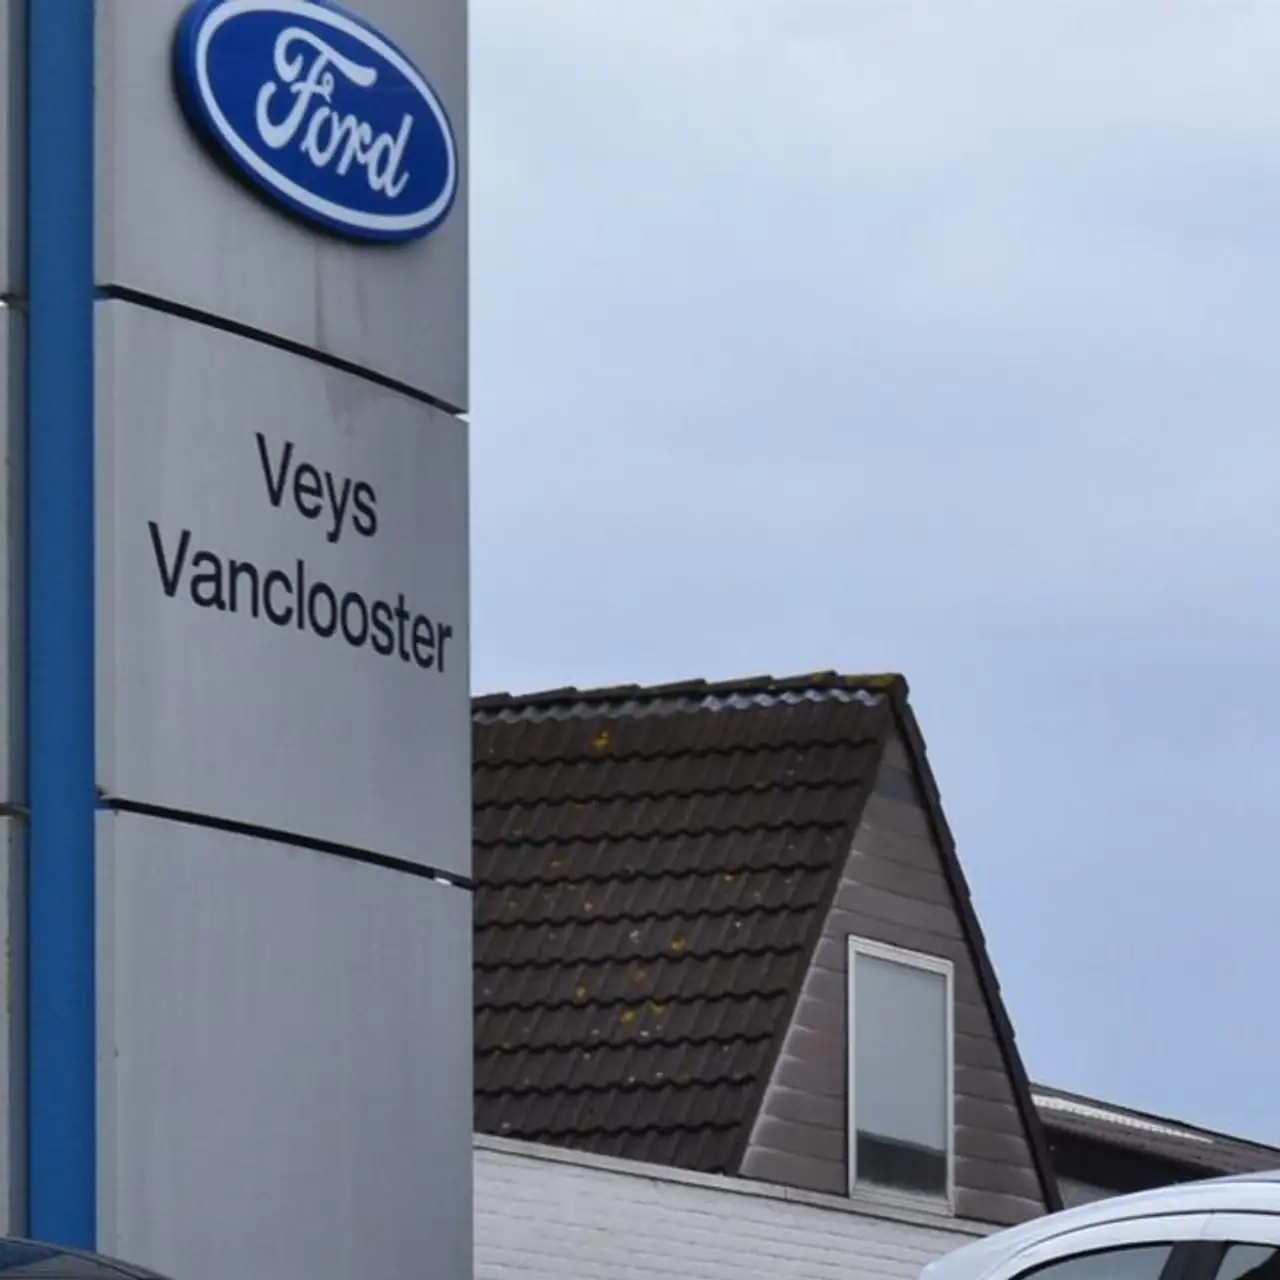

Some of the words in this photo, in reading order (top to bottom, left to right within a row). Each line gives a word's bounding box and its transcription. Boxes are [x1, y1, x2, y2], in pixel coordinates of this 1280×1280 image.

[255, 26, 415, 200] Ford
[256, 432, 379, 542] Veys
[148, 522, 452, 674] Vanclooster
